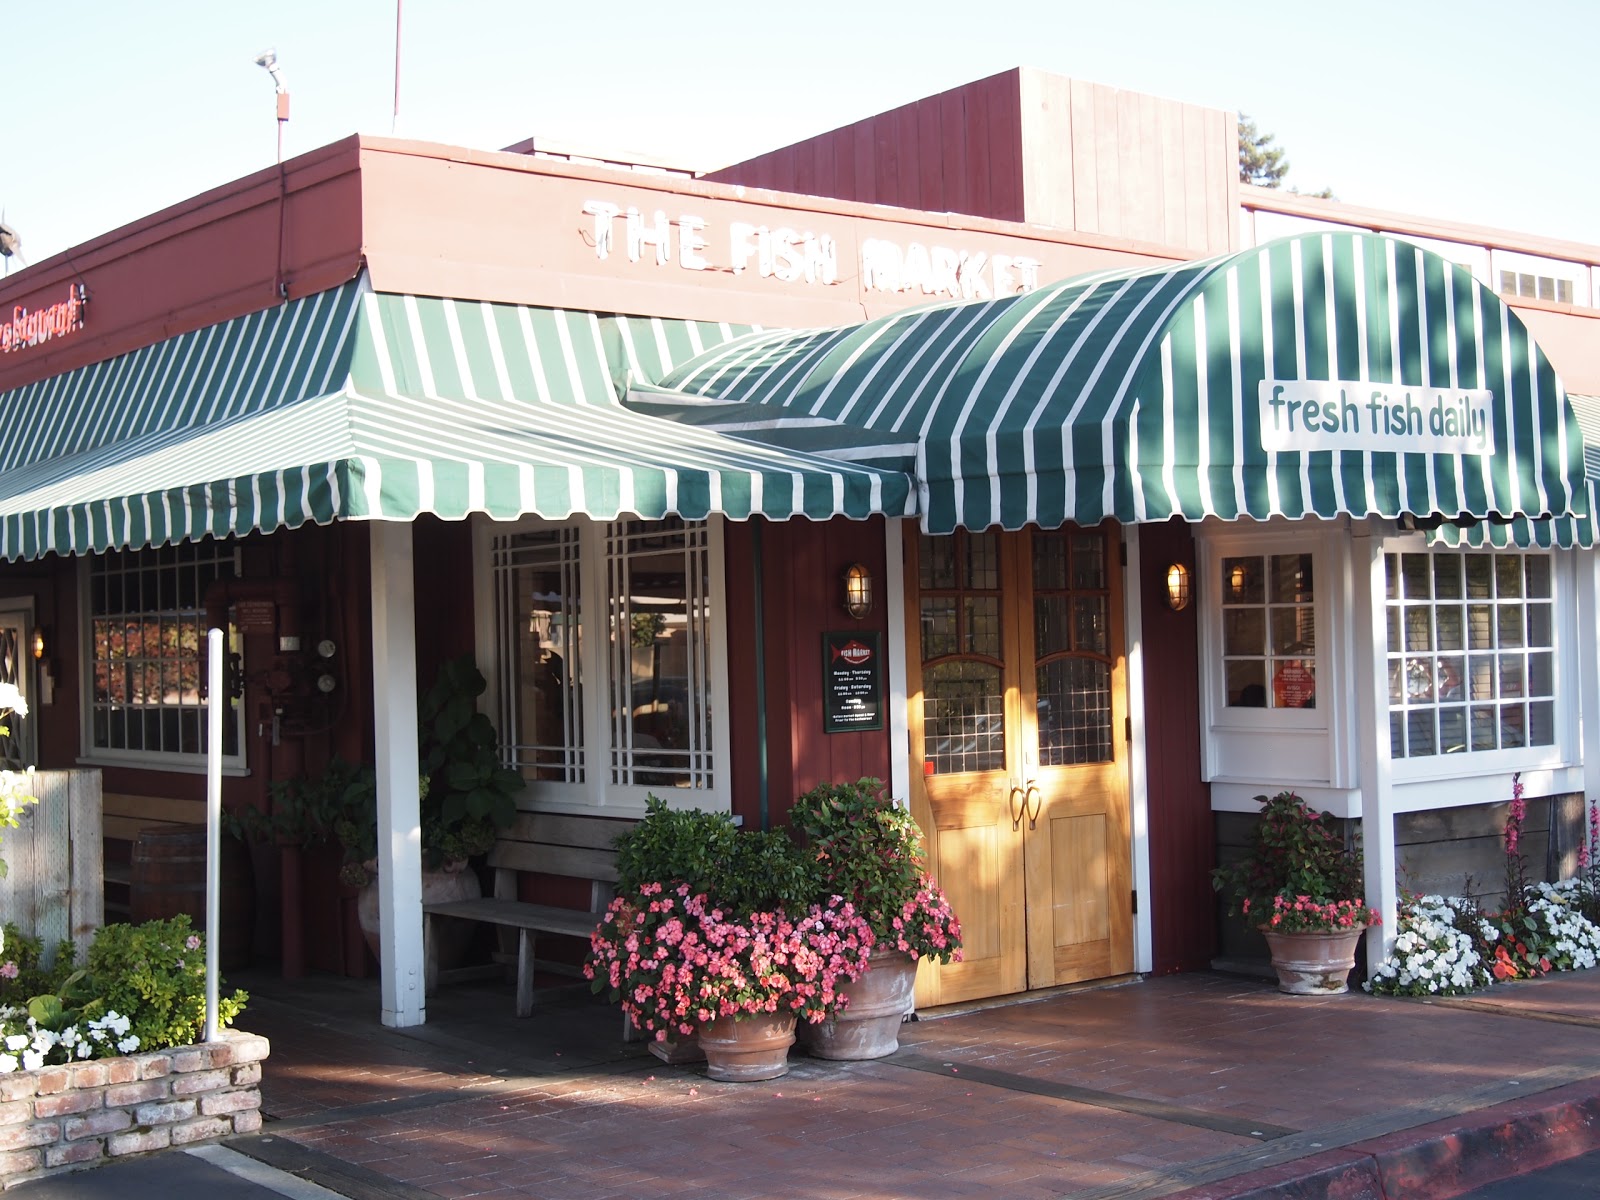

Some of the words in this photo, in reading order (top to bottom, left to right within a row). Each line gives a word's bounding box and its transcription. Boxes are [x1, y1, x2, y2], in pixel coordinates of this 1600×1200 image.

[583, 200, 709, 271] THE
[730, 221, 837, 285] FISH
[862, 237, 1043, 299] MARKET
[1268, 385, 1360, 433] fresh
[1366, 391, 1423, 436] fish
[1429, 394, 1487, 450] daily
[841, 649, 852, 658] FISH
[852, 648, 870, 658] MARKET
